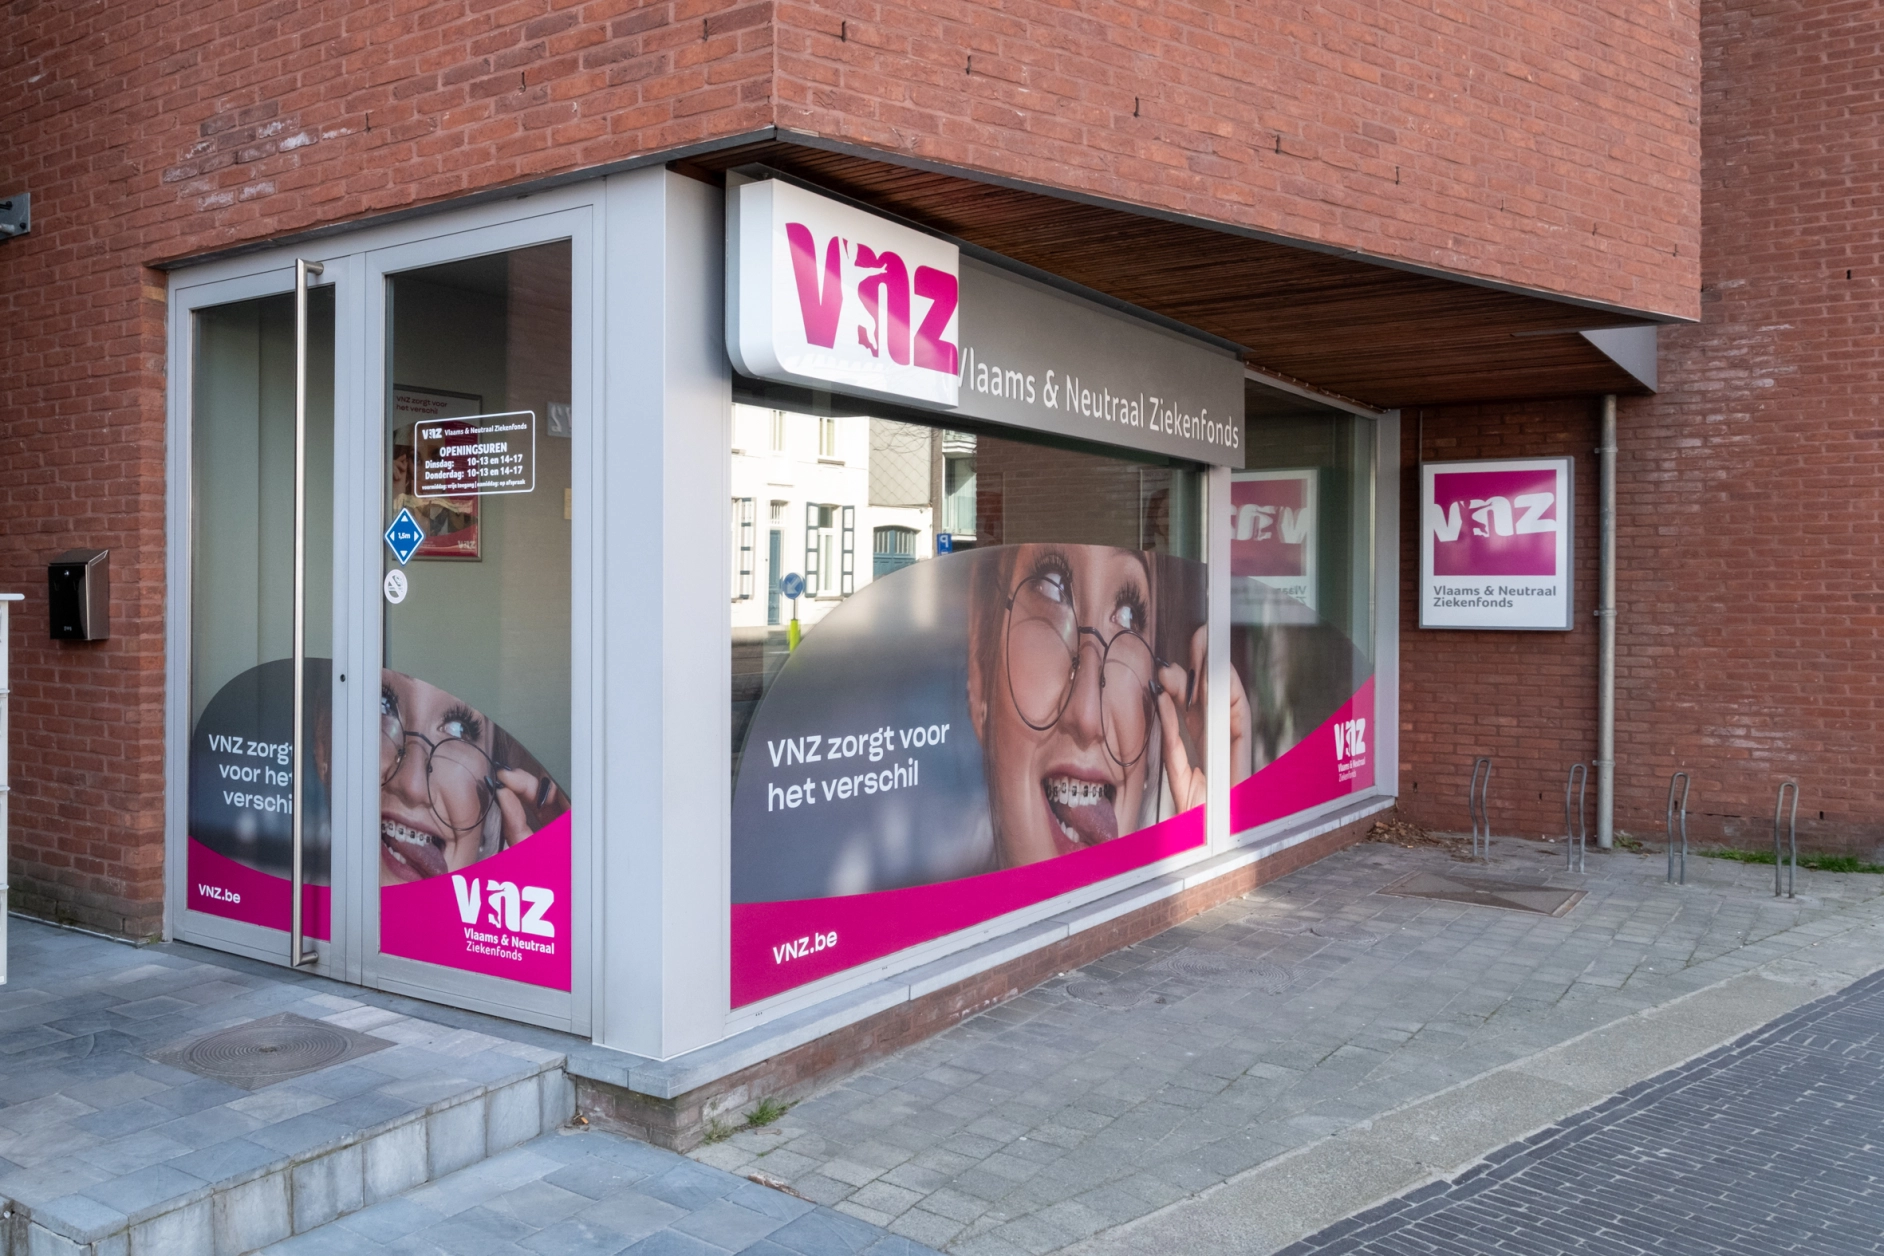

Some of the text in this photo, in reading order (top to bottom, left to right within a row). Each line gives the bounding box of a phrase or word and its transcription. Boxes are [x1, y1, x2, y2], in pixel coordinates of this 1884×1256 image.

[1043, 370, 1060, 409] &
[1066, 375, 1144, 428] Neutraal
[1150, 397, 1239, 449] Ziekenfonds
[470, 425, 493, 433] Neutraal
[494, 423, 527, 431] Ziekenfonds
[440, 442, 508, 457] OPENINGSUREN
[425, 460, 454, 469] Dinsdag:
[467, 456, 489, 466] 10-13
[500, 454, 523, 463] 14-17
[425, 470, 464, 480] Donderdag:
[467, 468, 489, 477] 10-13
[500, 465, 523, 475] 14-17
[1433, 585, 1557, 596] Vlaams & Neutraal
[1433, 597, 1514, 608] Ziekenfonds
[208, 733, 292, 765] VNZ zorg
[767, 723, 950, 767] VNZ zorgt voor
[219, 764, 292, 787] voor he
[768, 757, 919, 812] het verschil
[223, 790, 292, 815] verschi
[198, 883, 241, 904] VNZ.be
[463, 927, 555, 955] Vlaams & Neutraal
[466, 940, 523, 961] Ziekenfonds
[773, 931, 838, 965] VNZ.be
